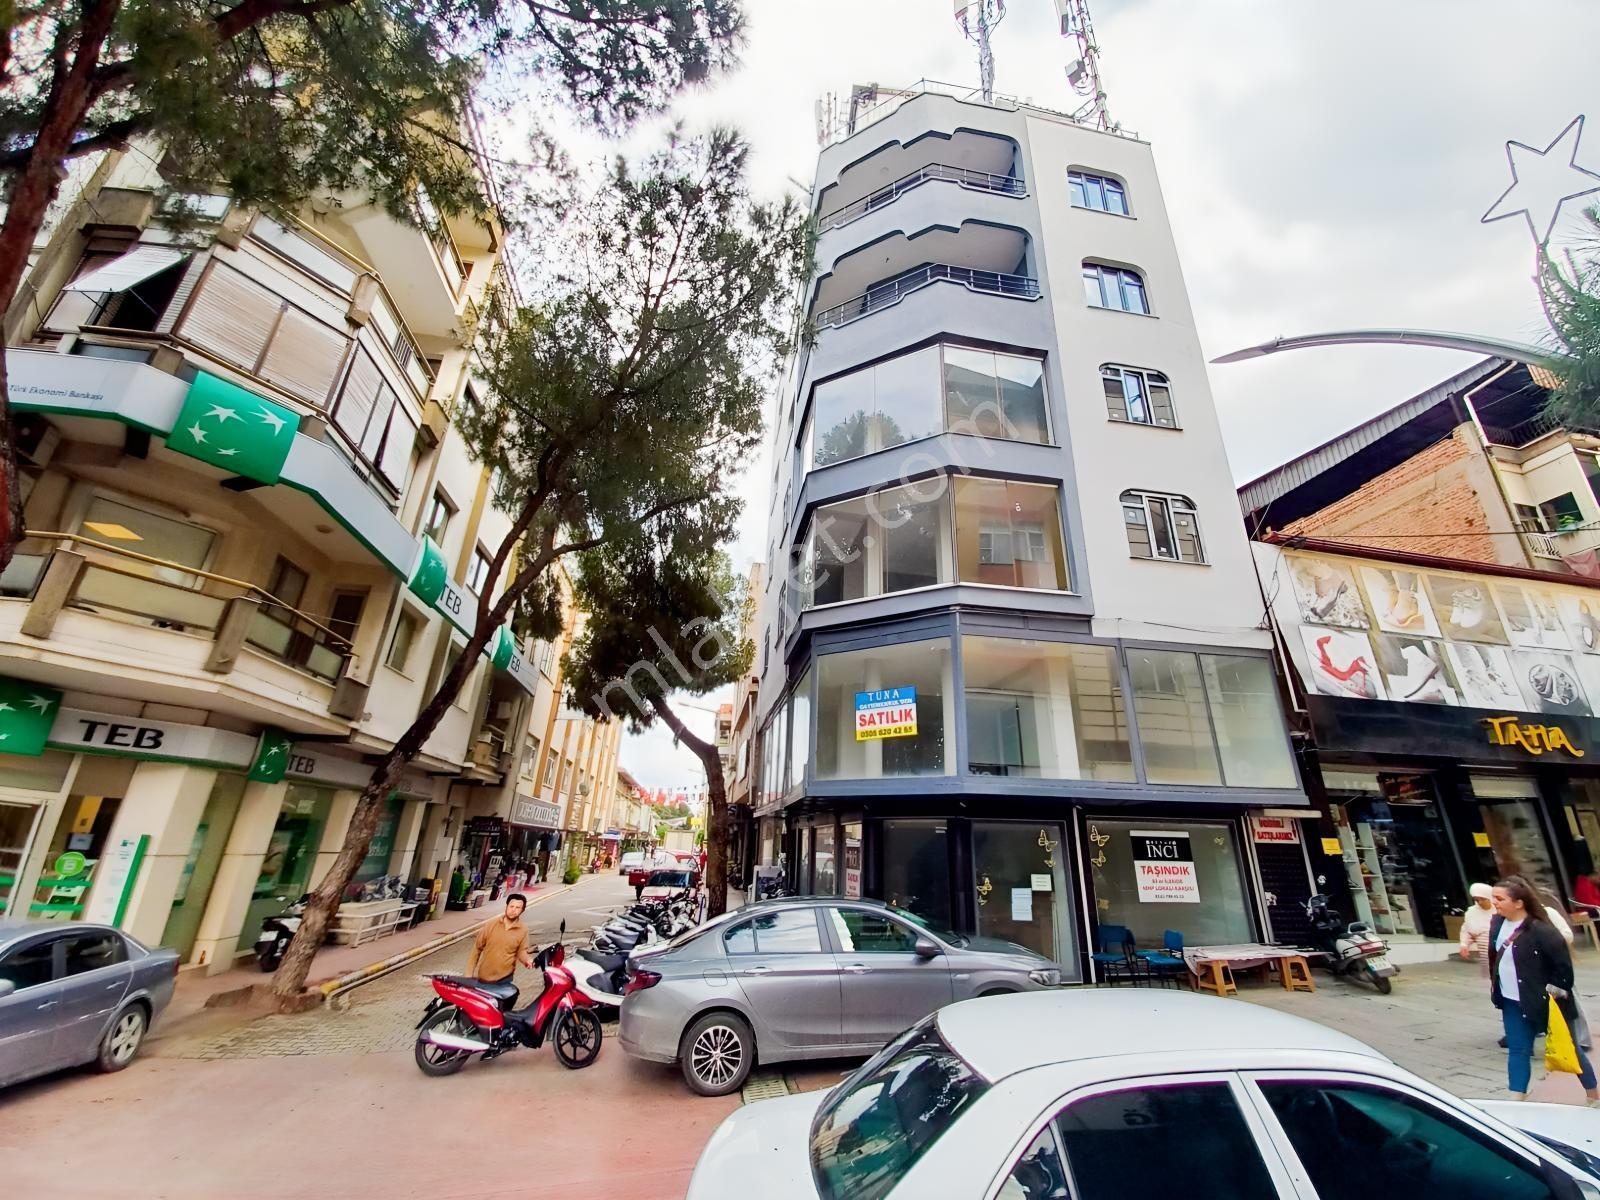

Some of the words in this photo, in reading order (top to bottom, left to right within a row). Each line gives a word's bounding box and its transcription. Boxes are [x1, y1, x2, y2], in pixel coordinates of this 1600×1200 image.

[28, 386, 67, 396] Ekonomi
[68, 390, 104, 401] Bankası
[440, 584, 462, 614] TEB
[859, 708, 914, 727] SATILIK
[79, 719, 164, 750] TEB
[288, 754, 315, 774] TEB
[1140, 865, 1190, 877] TAŞINDIK
